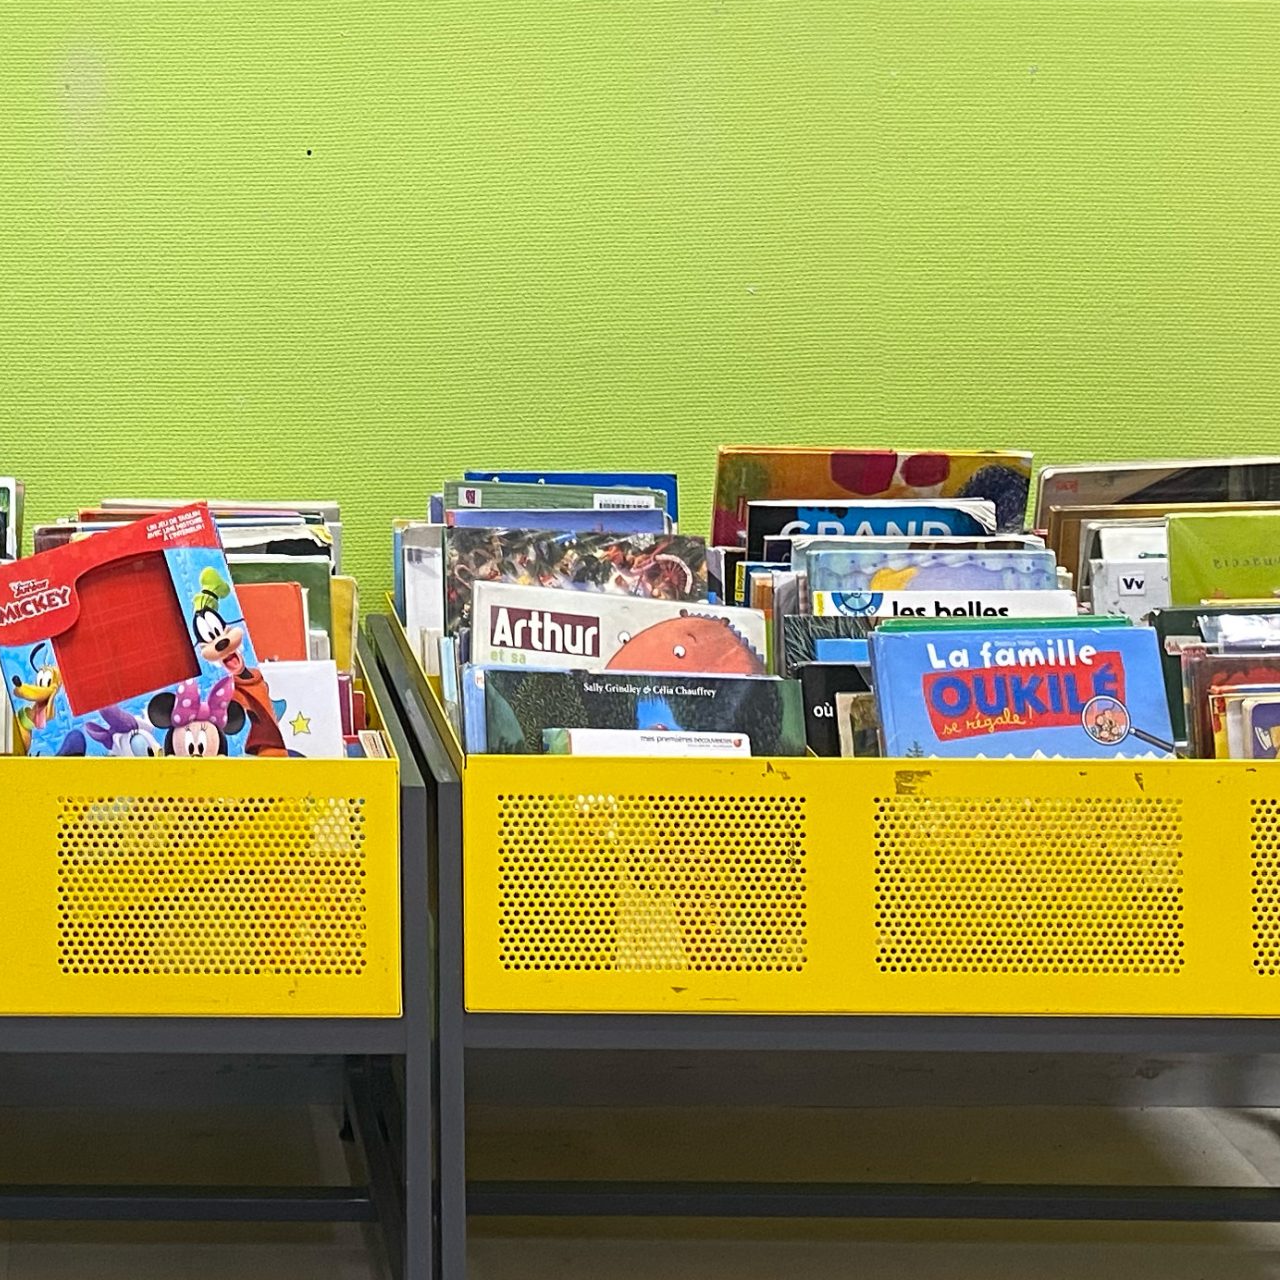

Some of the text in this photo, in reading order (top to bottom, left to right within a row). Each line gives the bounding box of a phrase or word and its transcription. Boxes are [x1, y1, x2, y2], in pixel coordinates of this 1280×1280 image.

[1122, 577, 1145, 590] Vv
[492, 608, 598, 655] Arthur
[490, 649, 526, 664] et sa
[927, 638, 1097, 669] La famille
[583, 682, 603, 694] Sally
[605, 683, 641, 695] Grindley
[931, 662, 1119, 718] OUKILÉ
[813, 701, 834, 718] où
[942, 724, 963, 736] se
